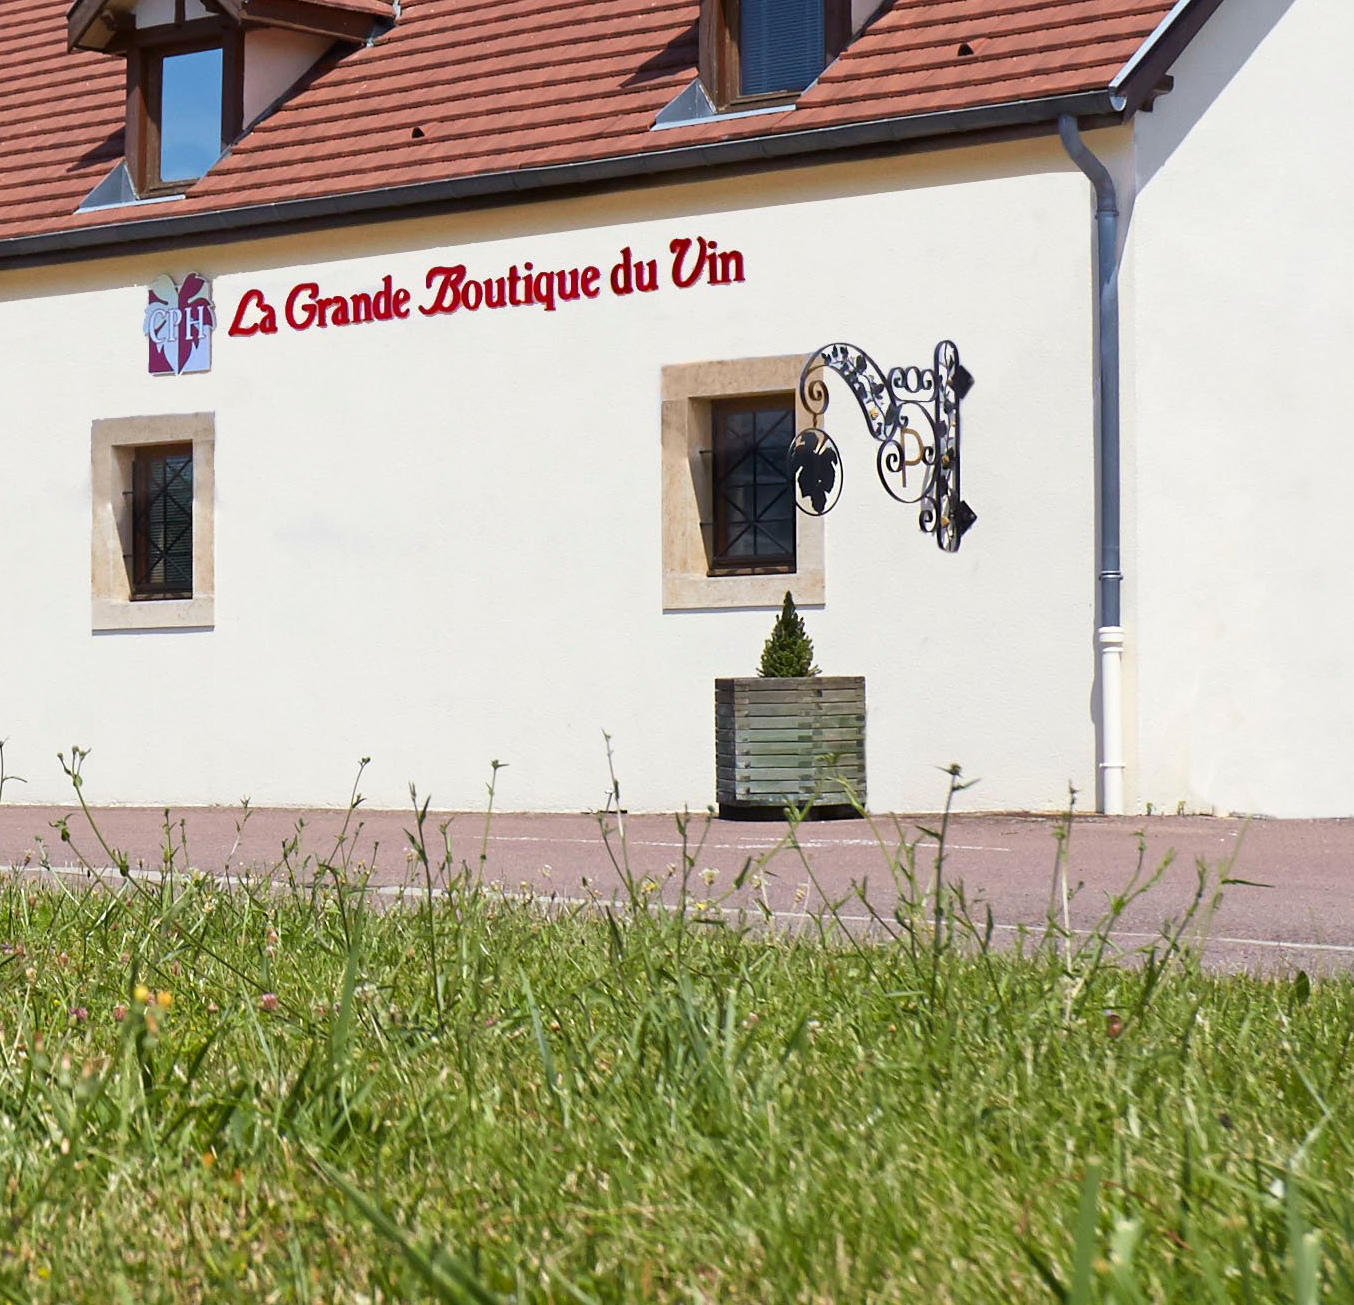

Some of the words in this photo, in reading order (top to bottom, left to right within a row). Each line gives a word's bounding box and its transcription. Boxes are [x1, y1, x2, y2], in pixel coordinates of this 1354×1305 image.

[228, 289, 278, 337] La
[284, 274, 412, 331] Grande
[418, 264, 601, 316] Boutique
[610, 246, 659, 296] du
[669, 236, 746, 289] Vin
[148, 304, 209, 346] CPH
